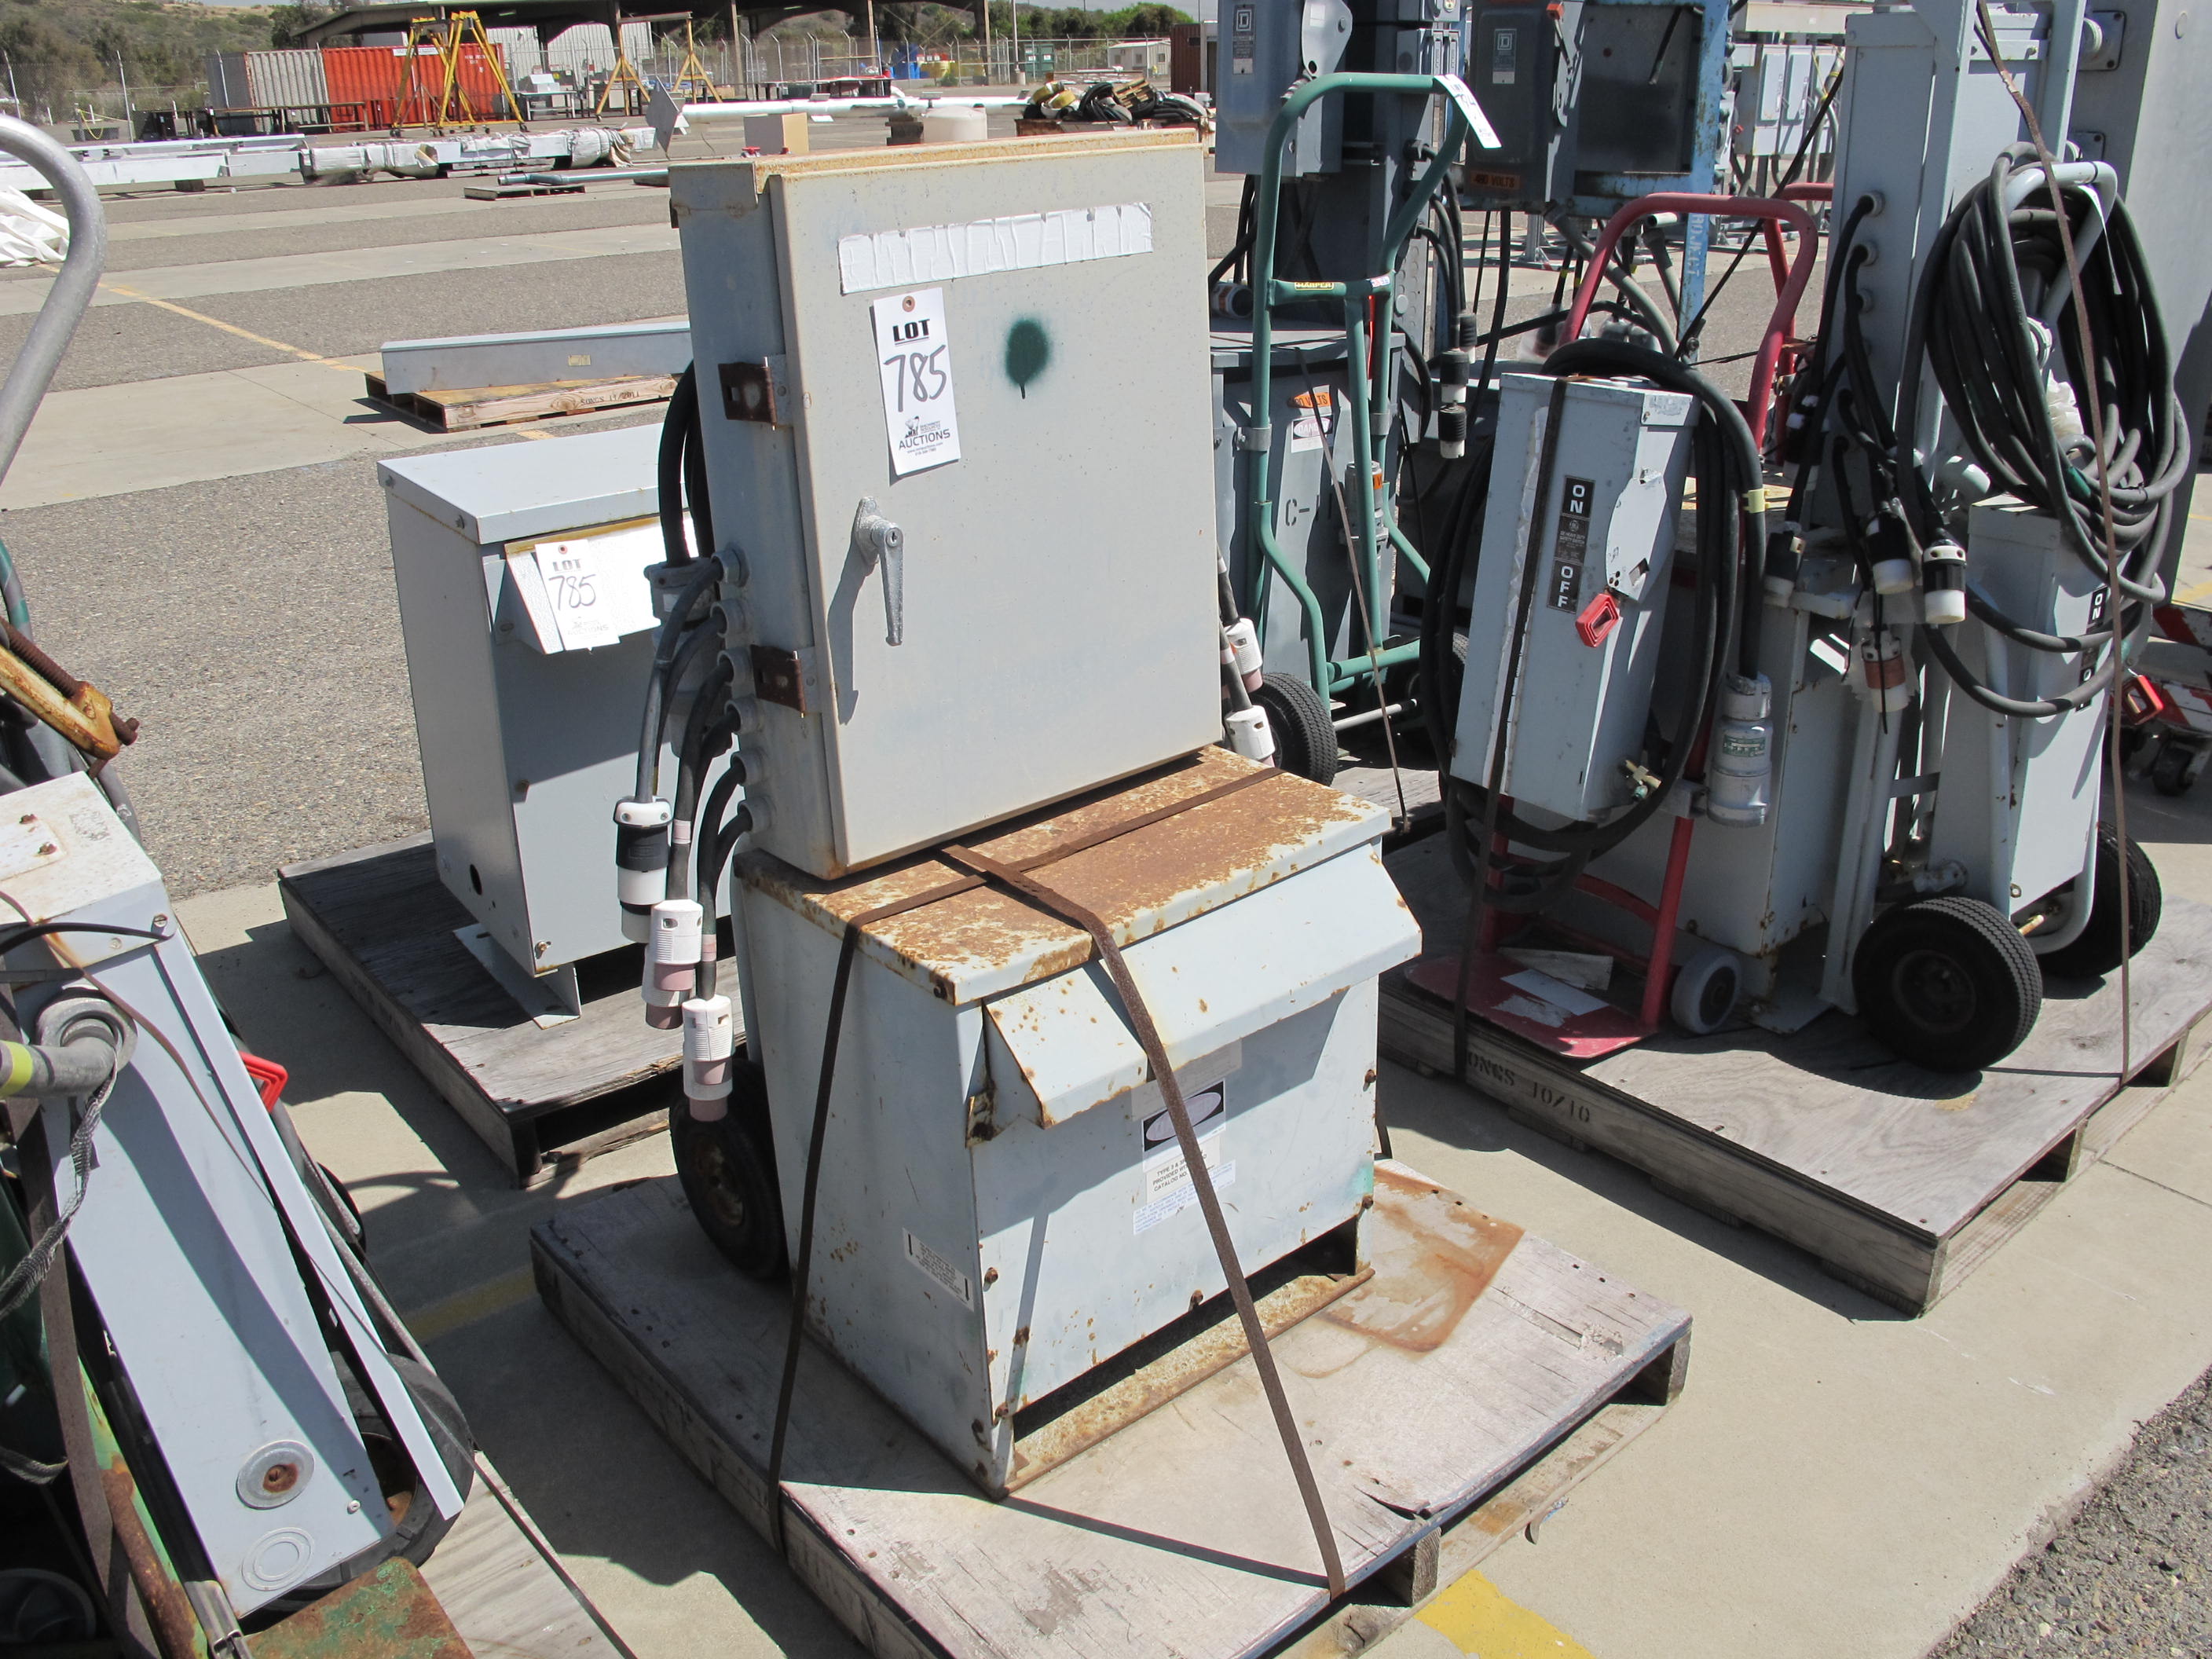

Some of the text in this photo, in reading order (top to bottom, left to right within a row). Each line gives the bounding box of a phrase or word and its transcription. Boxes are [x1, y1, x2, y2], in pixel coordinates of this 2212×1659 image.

[1491, 174, 1515, 189] VOLTS
[1687, 213, 1705, 277] ROJECT
[892, 318, 930, 342] LOT
[883, 344, 947, 412] 785
[899, 429, 950, 451] AUCTIONS
[1570, 484, 1586, 515] ON
[552, 558, 581, 572] LOT
[548, 573, 596, 611] 785
[1558, 565, 1574, 608] OFF
[2092, 593, 2104, 621] ON
[1467, 1051, 1591, 1123] ONGS 10/10
[1152, 1169, 1179, 1185] PROVIDED
[1154, 1175, 1179, 1192] CATALOG
[1157, 1166, 1170, 1177] TYPE
